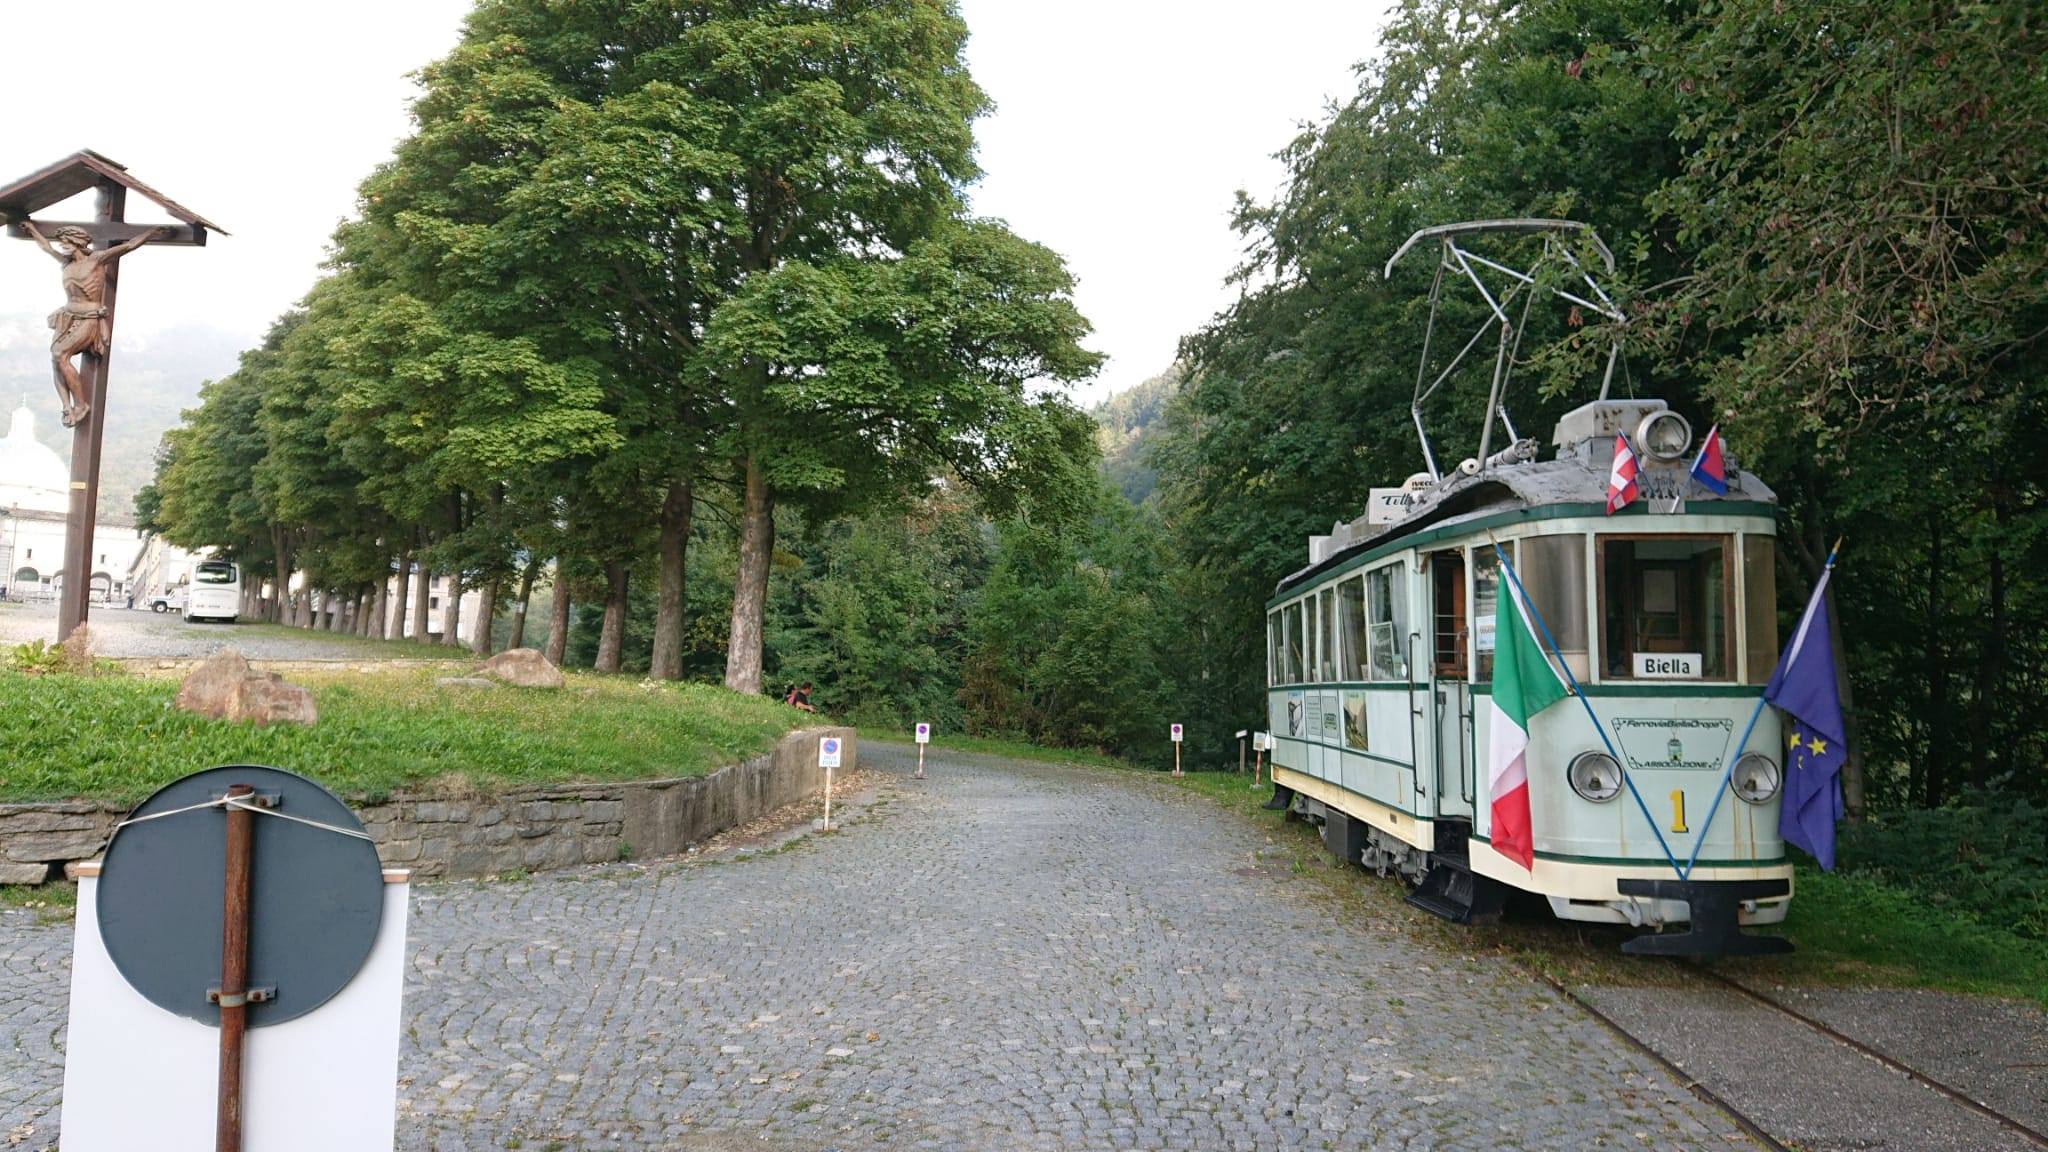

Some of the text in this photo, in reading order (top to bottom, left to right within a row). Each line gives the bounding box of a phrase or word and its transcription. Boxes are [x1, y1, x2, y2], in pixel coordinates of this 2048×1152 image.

[1645, 658, 1690, 674] Biella
[1644, 760, 1708, 769] ASSOCIAZIONE
[1669, 789, 1689, 833] 1
